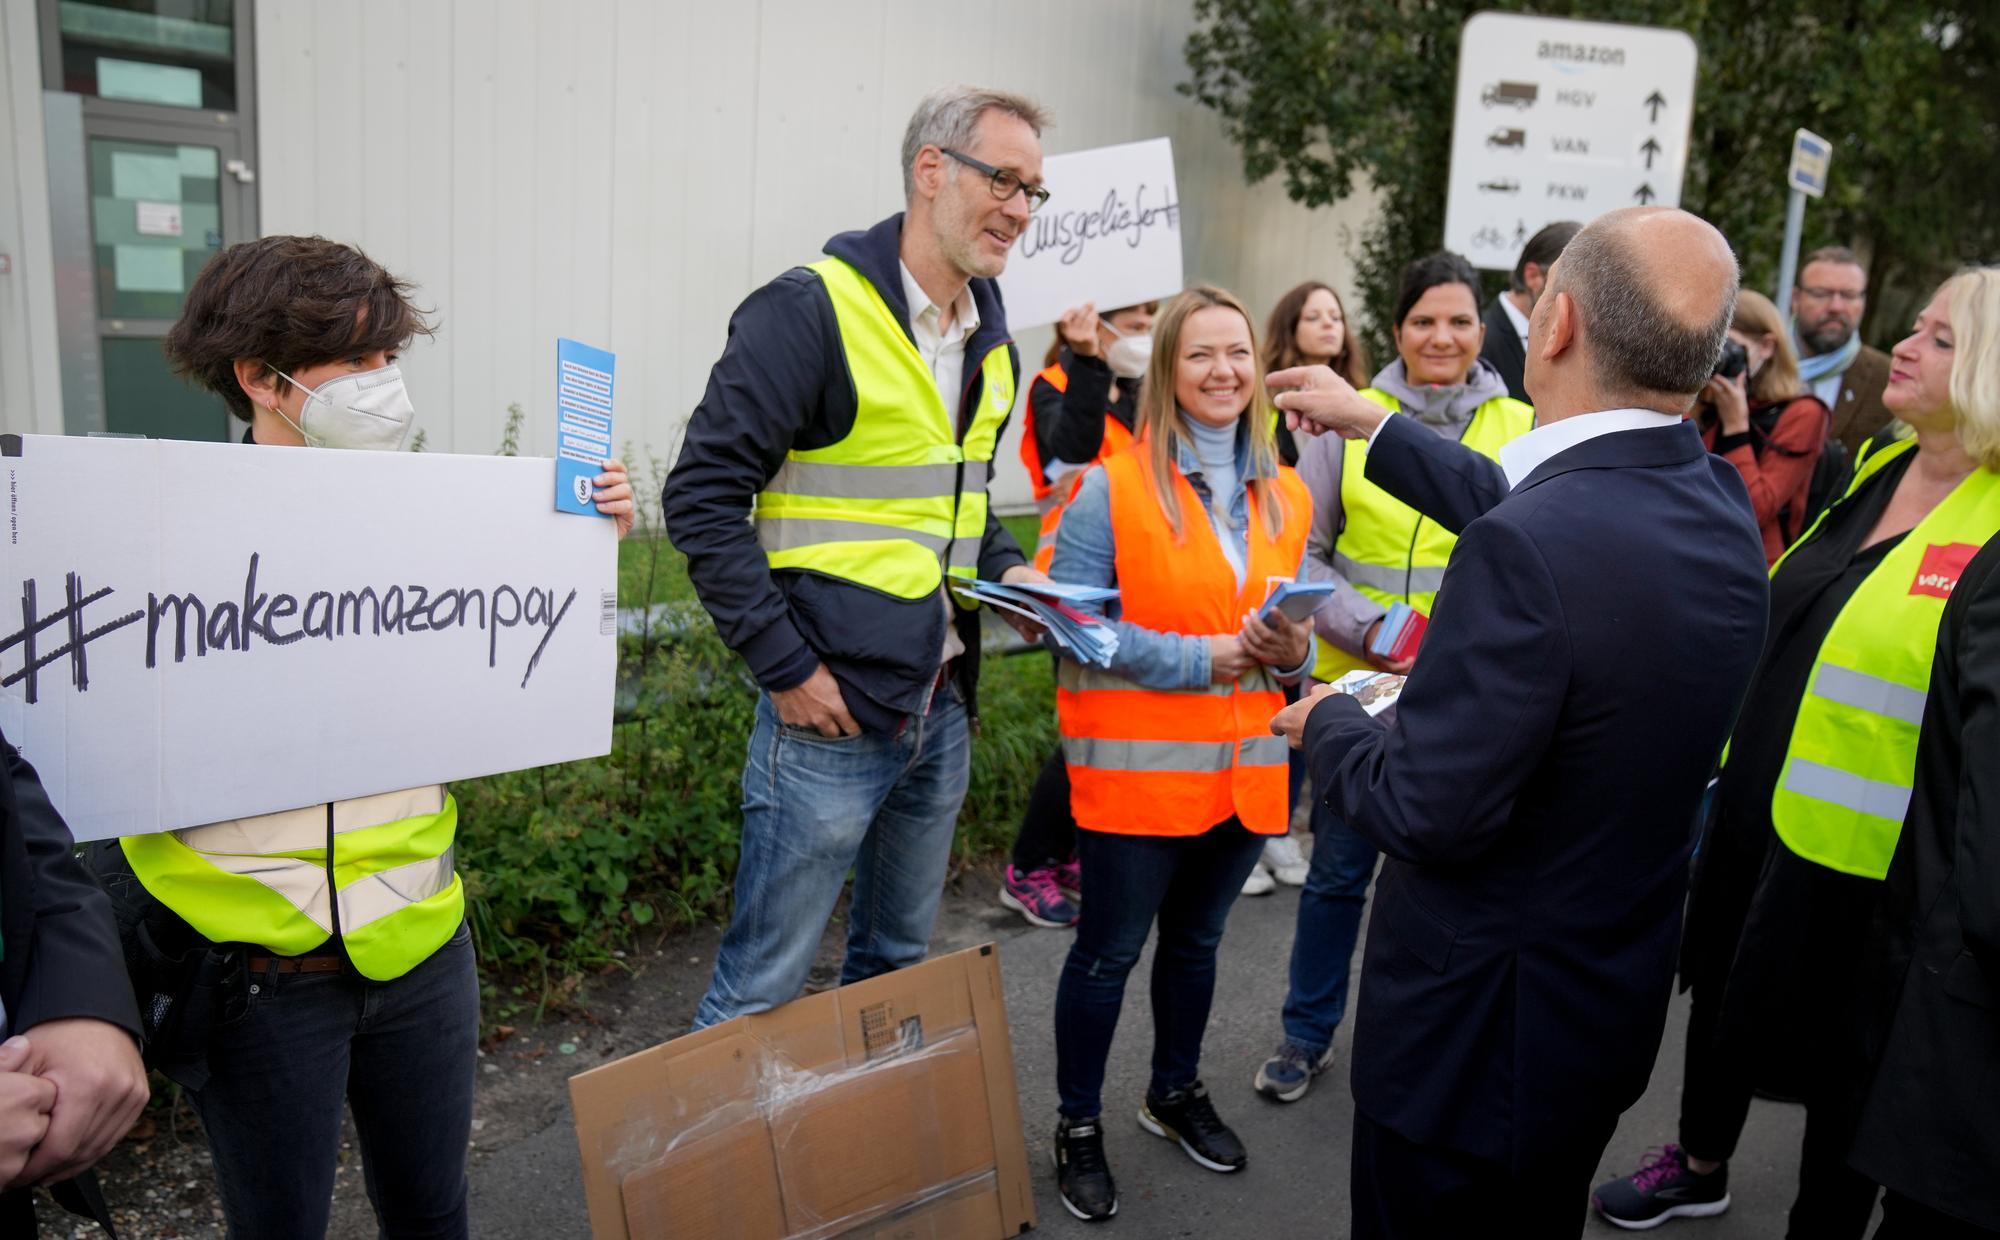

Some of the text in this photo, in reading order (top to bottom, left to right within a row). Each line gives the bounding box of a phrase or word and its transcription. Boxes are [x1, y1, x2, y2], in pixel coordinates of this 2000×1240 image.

[1537, 40, 1625, 66] amazon
[1556, 89, 1597, 108] HGV
[1550, 136, 1590, 154] VAN
[1546, 181, 1589, 201] PKW
[1020, 183, 1179, 265] ausgeliefert
[0, 552, 577, 704] #makeamazonpay
